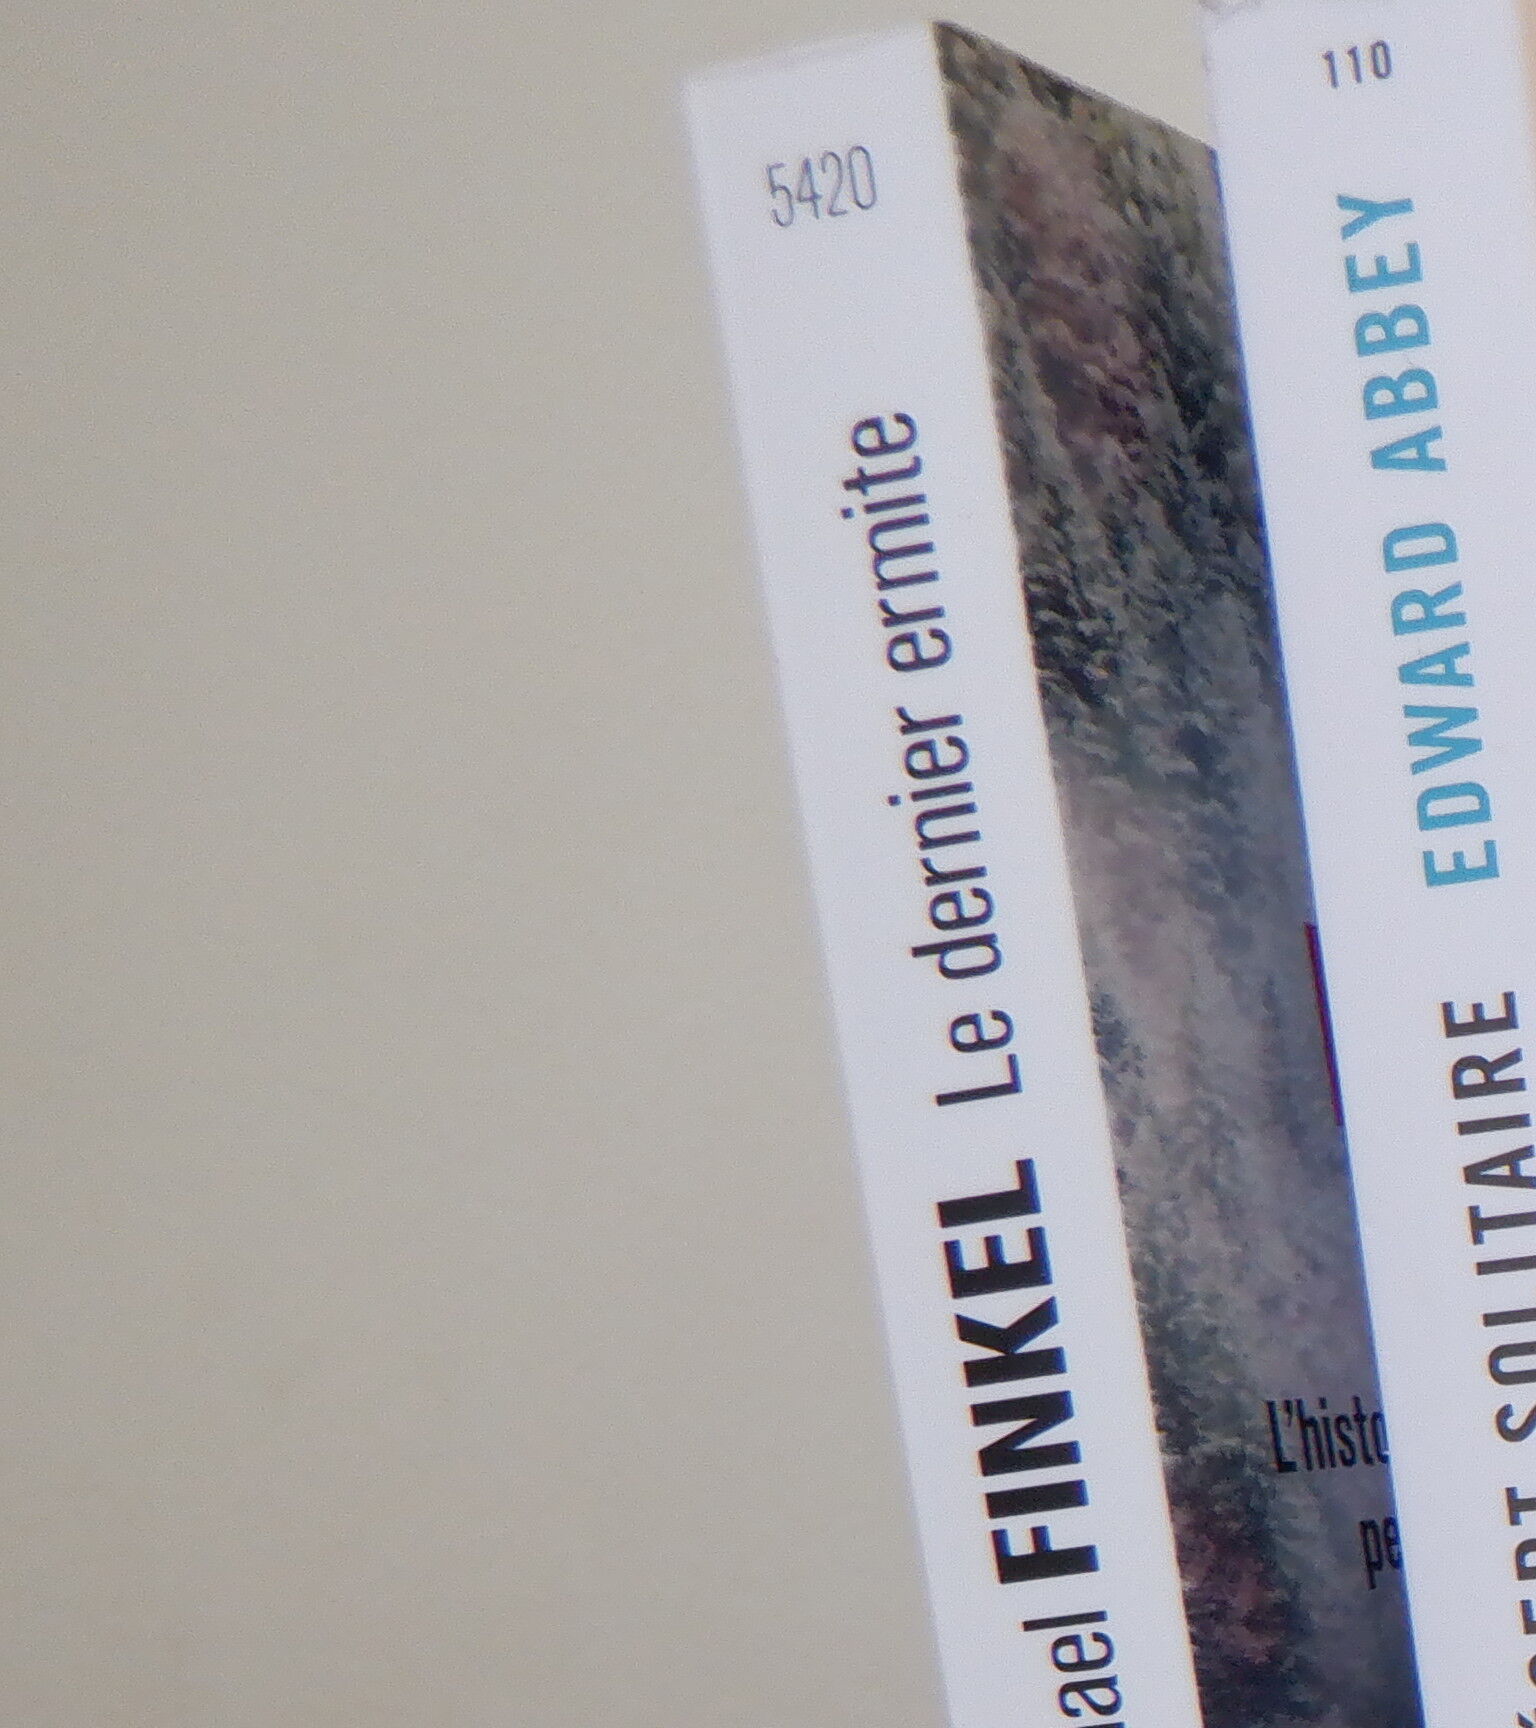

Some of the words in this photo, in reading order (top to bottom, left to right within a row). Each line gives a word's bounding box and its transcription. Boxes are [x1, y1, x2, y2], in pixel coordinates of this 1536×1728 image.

[765, 144, 878, 229] 5420
[1322, 39, 1393, 89] 110
[1336, 194, 1447, 472] ABBEY
[840, 412, 952, 673] ermite
[1382, 522, 1500, 888] EDWARD
[887, 706, 1002, 980] dernier
[935, 1009, 1022, 1107] Le
[936, 1158, 1099, 1585] FINKEL
